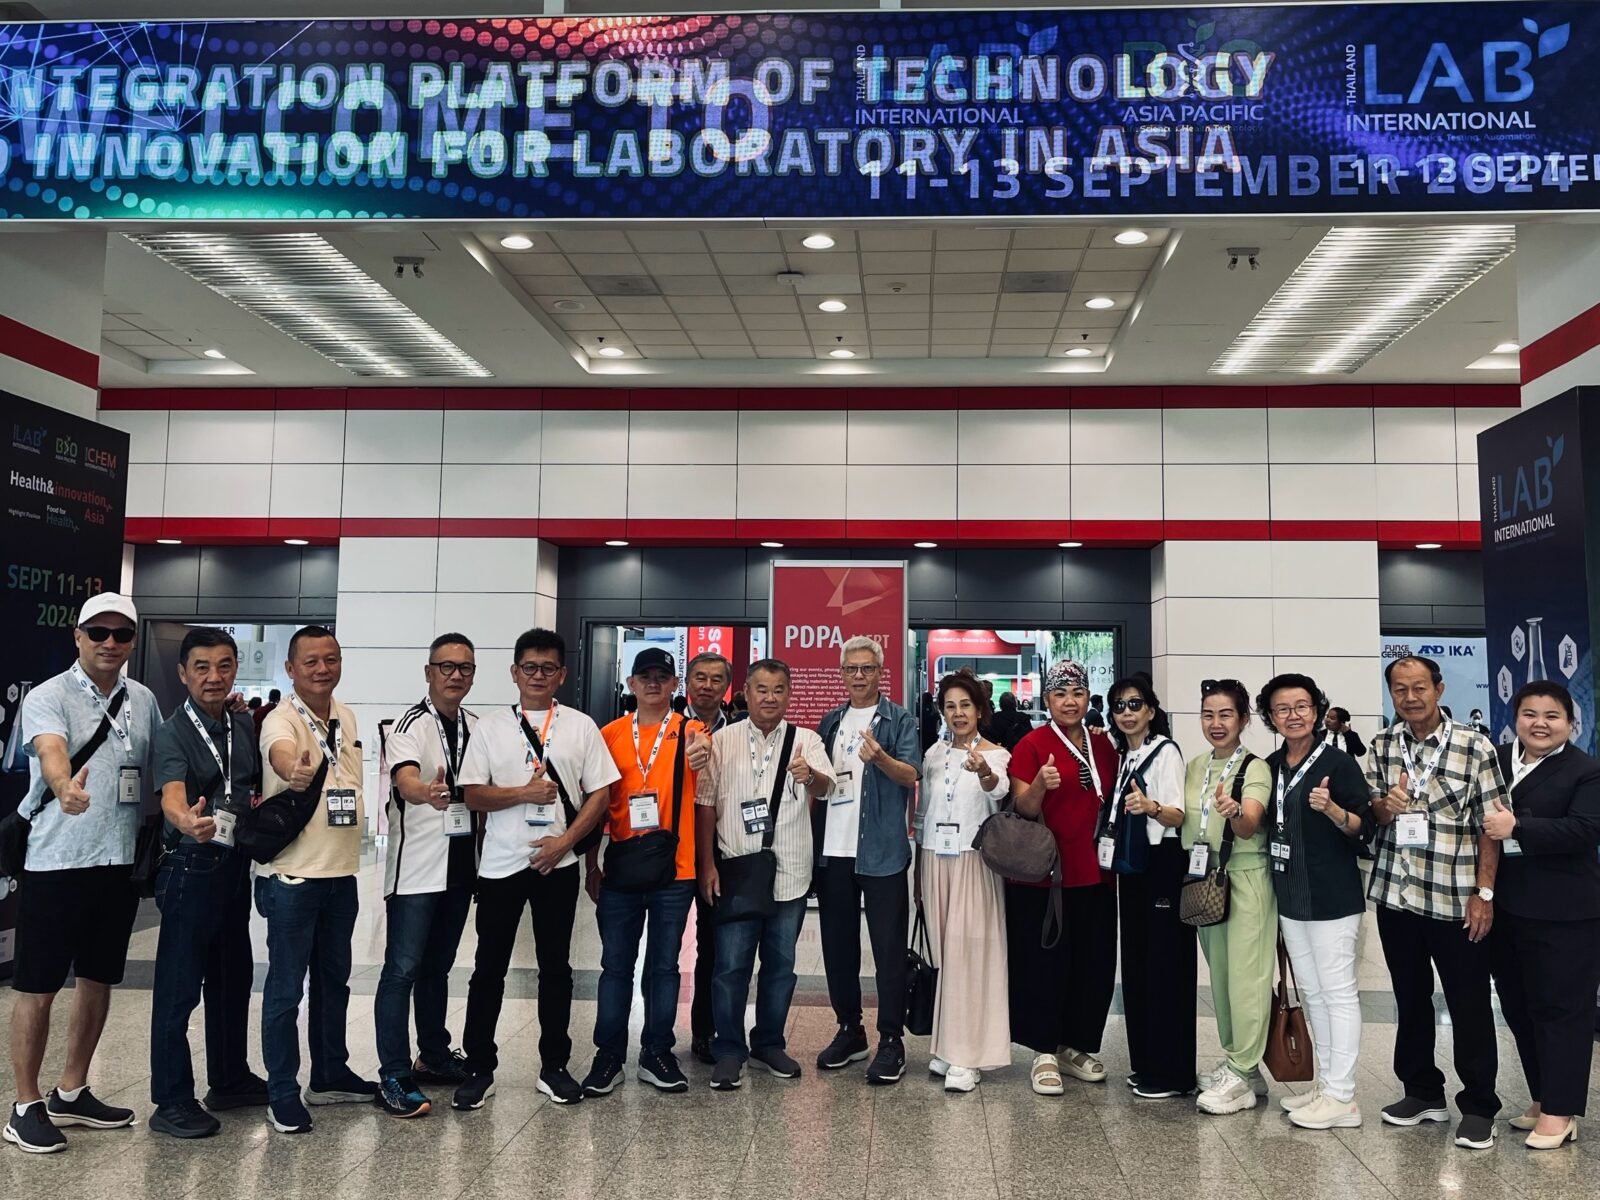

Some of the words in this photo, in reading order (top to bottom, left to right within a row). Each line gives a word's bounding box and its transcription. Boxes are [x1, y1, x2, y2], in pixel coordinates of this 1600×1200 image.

[411, 60, 733, 109] PLATFORM
[752, 59, 834, 107] OF
[855, 50, 1275, 104] TECHNOLOGY
[1346, 44, 1357, 106] THAILAND
[1363, 40, 1536, 105] LAB
[14, 78, 581, 165] WELCOME
[855, 107, 1024, 125] INTERNATIONAL
[1122, 106, 1176, 122] ASIA
[1181, 104, 1265, 121] PACIFIC
[1346, 111, 1536, 131] INTERNATIONAL
[34, 132, 408, 179] INNOVATION
[431, 130, 551, 178] FOR
[574, 126, 979, 177] LABORATORY
[1000, 126, 1062, 176] IN
[1090, 125, 1241, 175] ASIA
[1043, 151, 1402, 199] SEPTEMBER
[1425, 150, 1574, 194] 2024
[1471, 153, 1600, 183] SEPTE
[1497, 455, 1554, 522] LAB
[84, 507, 105, 525] Asia
[1494, 512, 1556, 544] INTERNATIONAL
[7, 564, 52, 593] SEPT
[784, 624, 844, 649] PDPA
[308, 721, 317, 733] IKA
[1307, 754, 1317, 765] IKA
